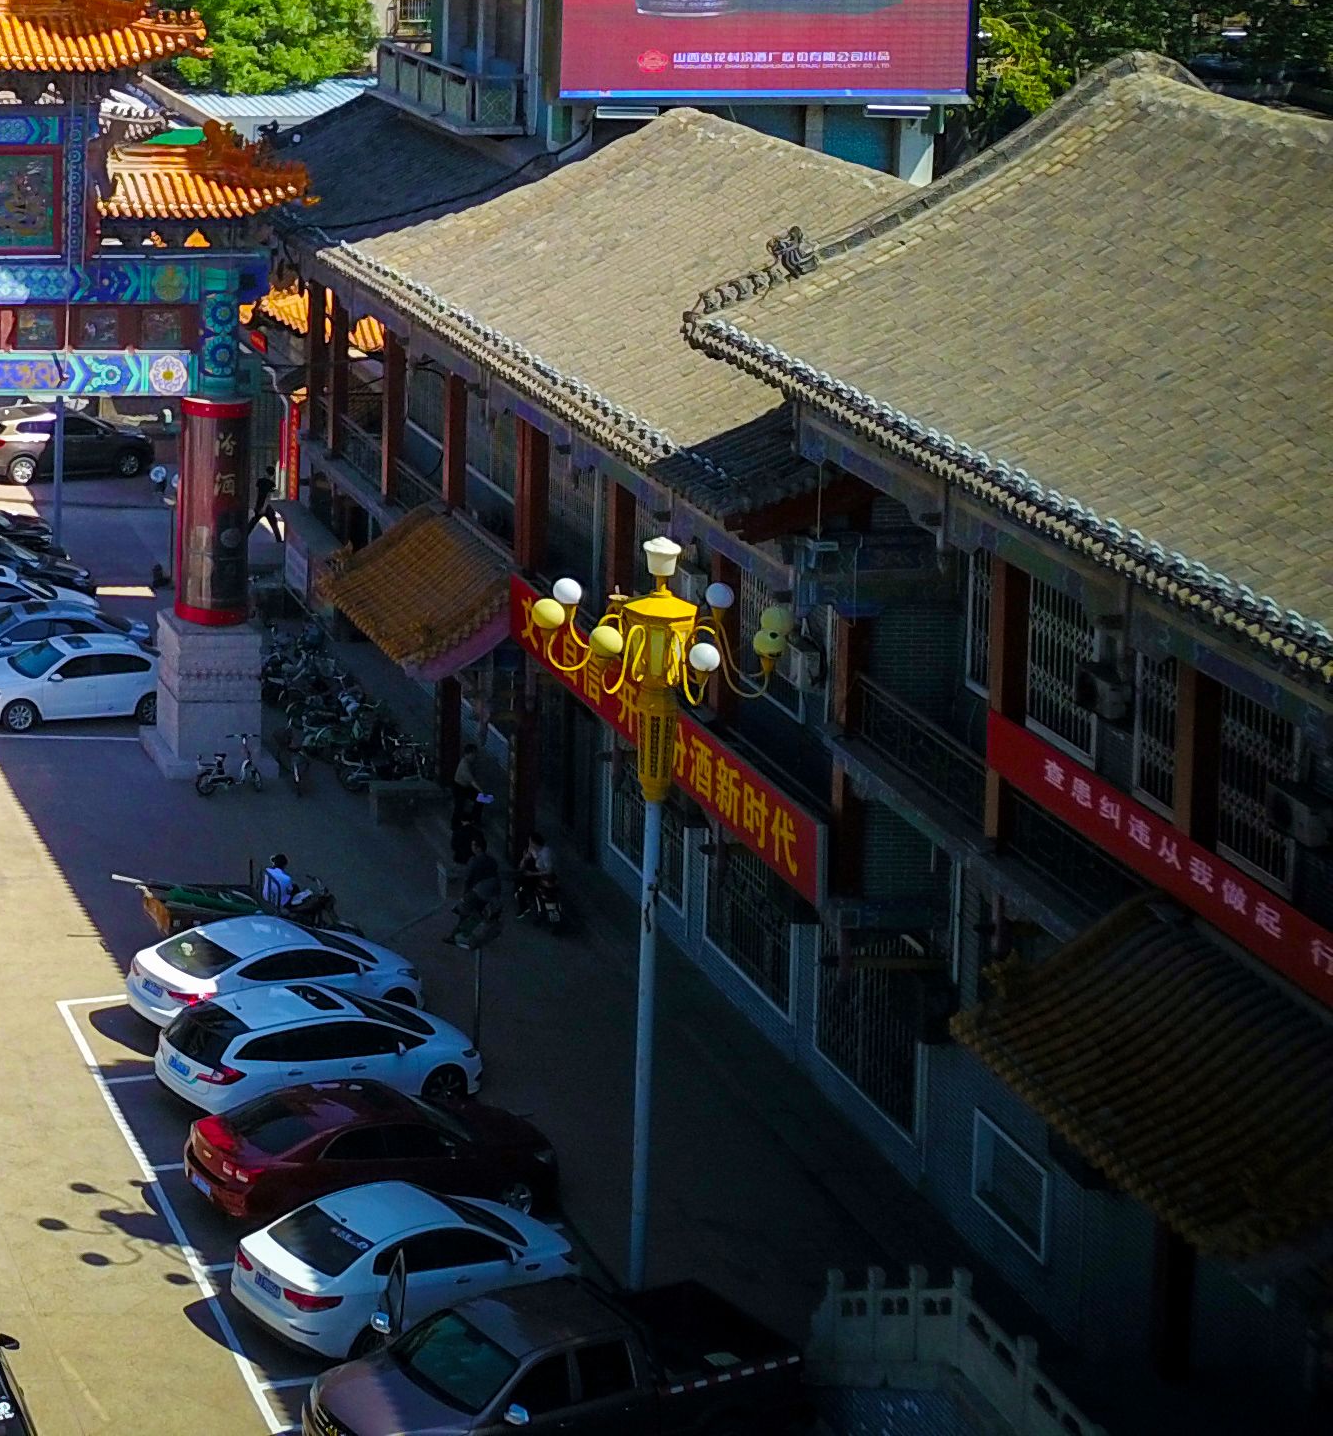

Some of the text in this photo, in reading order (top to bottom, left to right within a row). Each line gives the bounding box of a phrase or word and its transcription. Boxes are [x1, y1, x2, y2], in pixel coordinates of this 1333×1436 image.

[213, 432, 237, 497] 汾酒
[617, 680, 798, 876] 开酒新时代
